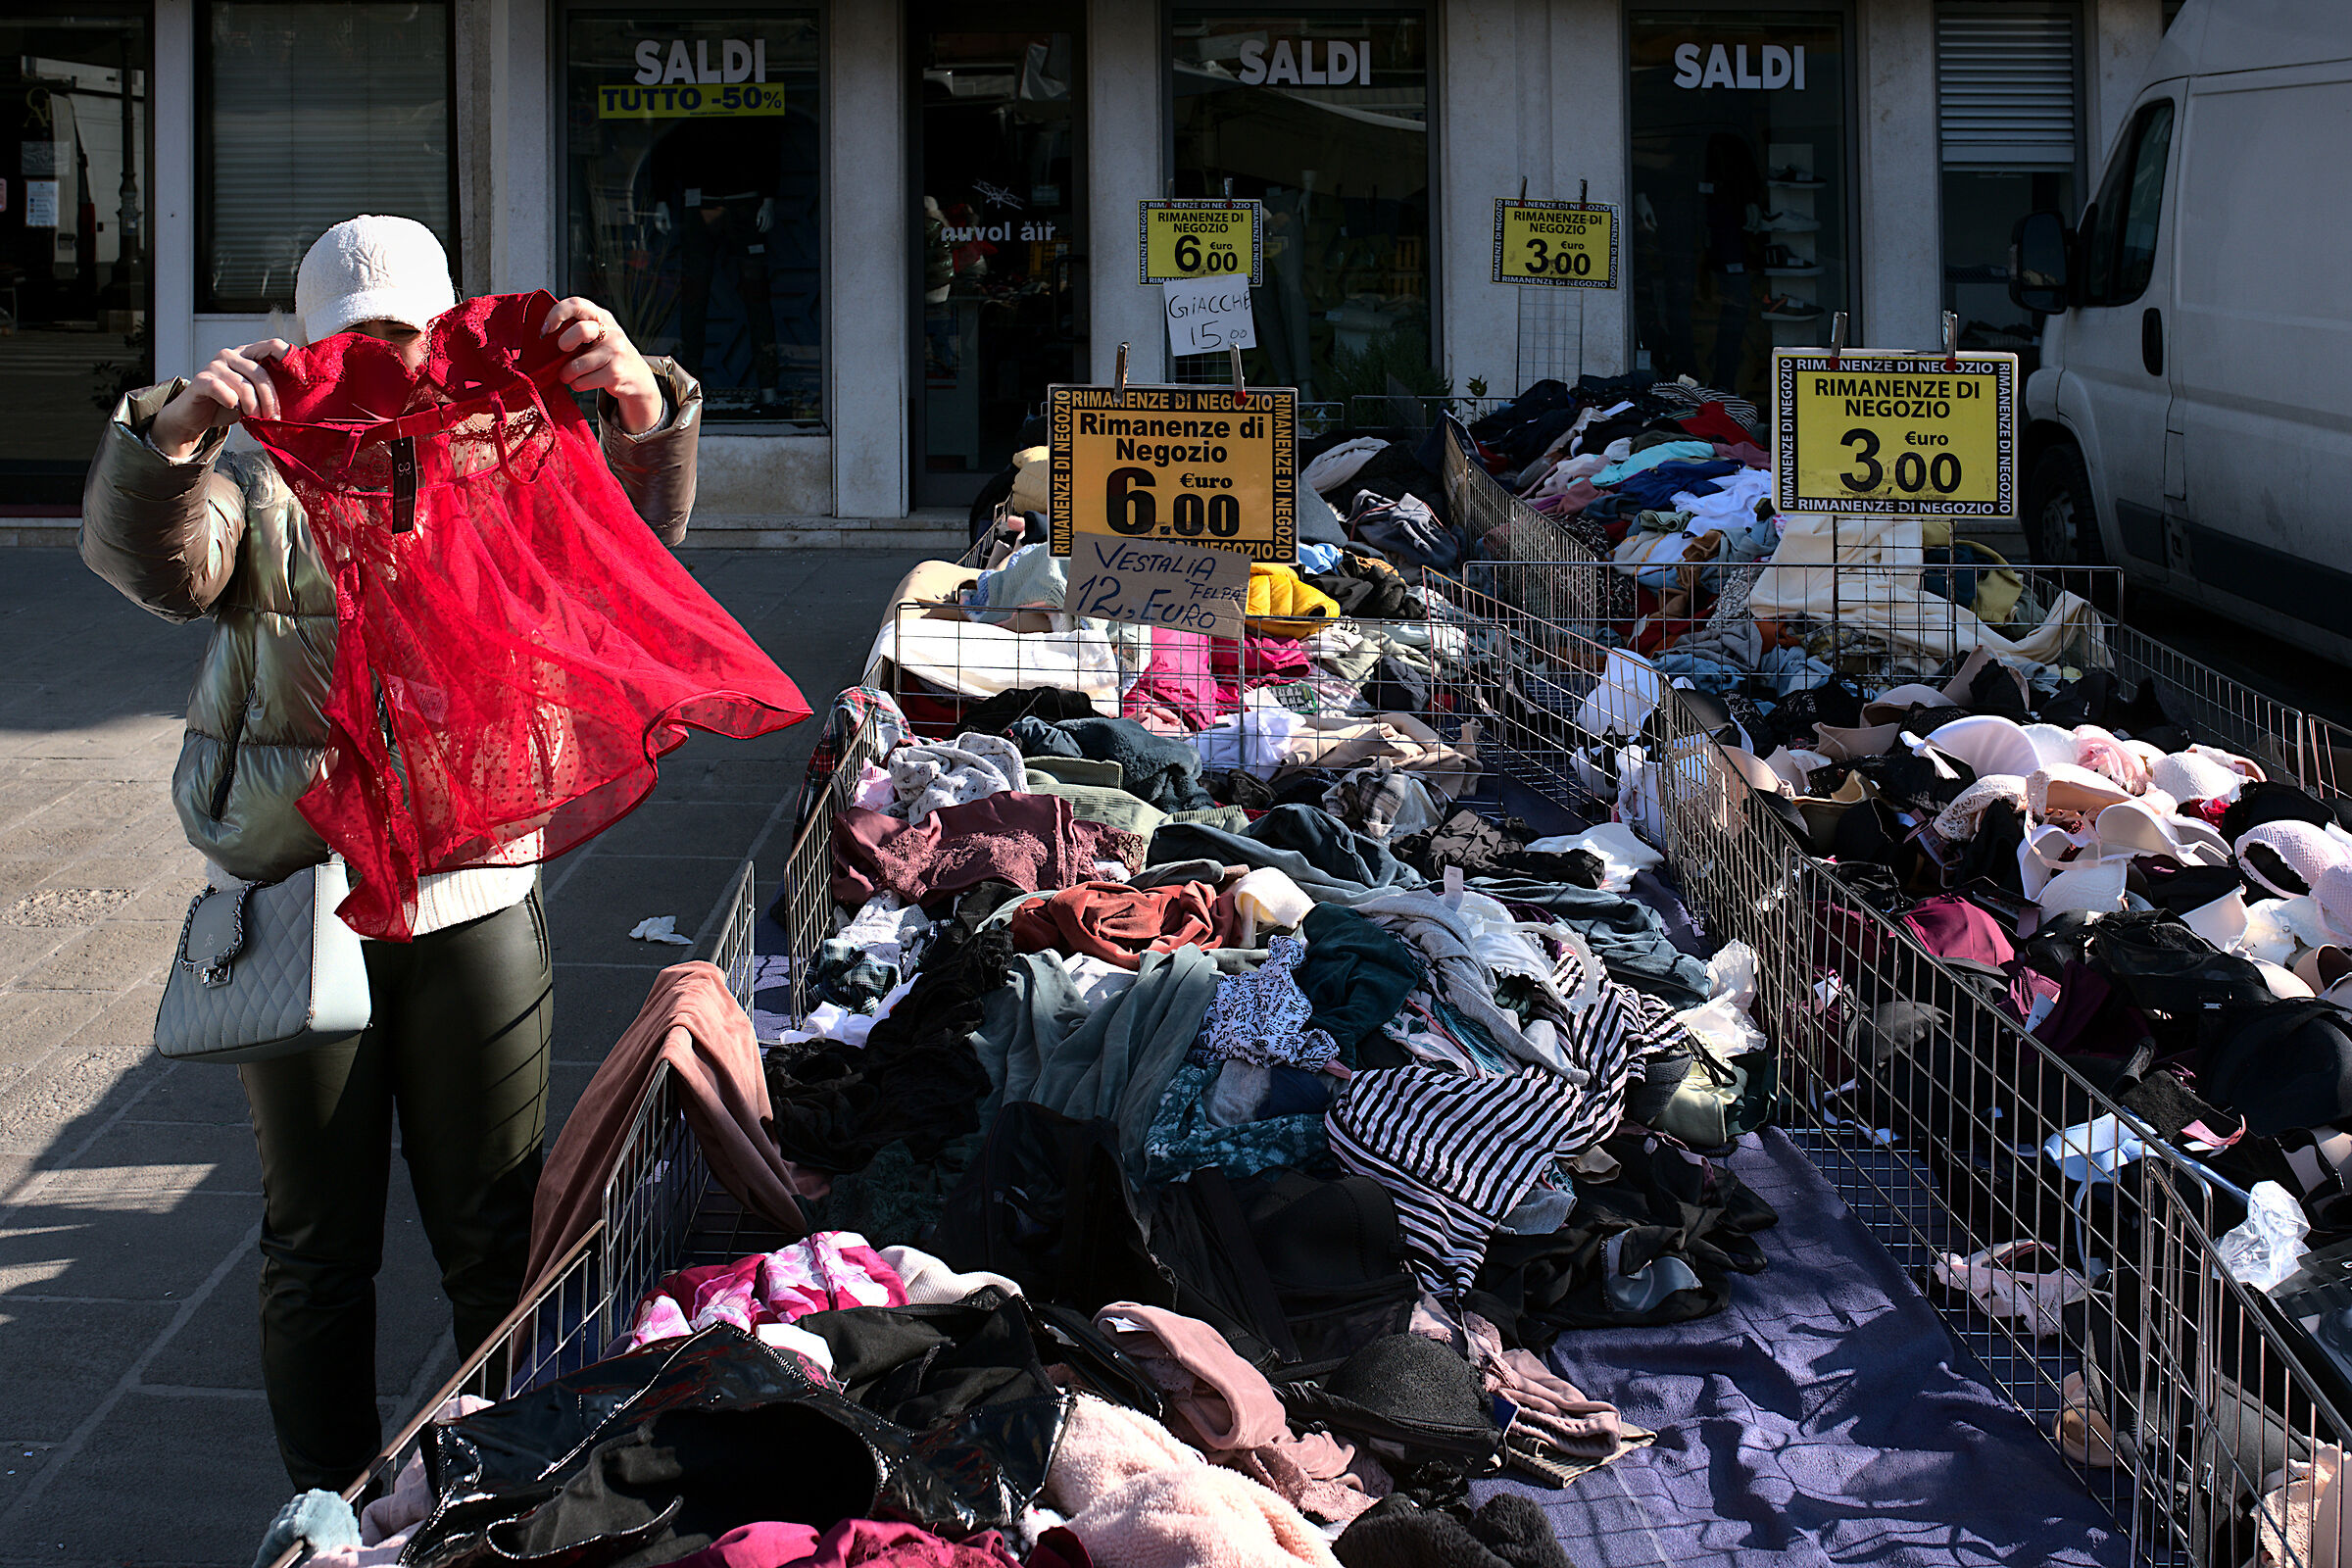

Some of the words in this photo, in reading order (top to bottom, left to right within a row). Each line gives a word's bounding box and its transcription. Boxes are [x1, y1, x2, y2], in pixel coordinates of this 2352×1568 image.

[634, 38, 765, 85] SALDI
[1238, 39, 1371, 85] SALDI
[1673, 42, 1805, 90] SALDI
[602, 87, 702, 112] TUTTO
[711, 86, 782, 110] -50%
[1157, 213, 1229, 222] RIMANENZE
[1231, 213, 1244, 222] DI
[1570, 203, 1609, 212] NEOZIO
[1174, 223, 1229, 233] NEGOZIO
[1514, 211, 1587, 224] RIMANENZE
[1589, 216, 1602, 225] DI
[941, 221, 1010, 241] nuvol
[1020, 225, 1056, 241] air
[1529, 222, 1586, 235] NEGOZIO
[1502, 275, 1553, 285] RIMANENZE
[1567, 279, 1607, 288] NEGOZIO
[1796, 359, 1893, 371] RIMNENZE
[1897, 361, 1914, 372] DI
[1781, 359, 1793, 416] NEGOZIO
[1815, 378, 1951, 398] RIMANENZE
[1957, 381, 1981, 399] DI
[1175, 393, 1192, 410] DI
[1845, 399, 1951, 418] NEGOZIO
[1999, 363, 2011, 437] RIMANENZE
[1054, 390, 1071, 452] NEGOZIO
[1080, 413, 1230, 438] Rimanenze
[1240, 416, 1264, 439] di
[1782, 418, 1793, 432] DI
[1275, 394, 1293, 476] RIMANENZE
[1116, 438, 1227, 467] Negozio
[1999, 440, 2011, 454] DI
[1054, 456, 1071, 469] DI
[1782, 434, 1793, 509] RIMANENZE
[1276, 479, 1293, 493] DI
[1999, 457, 2011, 514] NEGOZIO
[1054, 473, 1070, 555] RIMANENZE
[1798, 499, 1894, 514] RIMANENZE
[1898, 501, 1916, 514] DI
[1920, 502, 1994, 514] NEGOZIO
[1275, 497, 1293, 560] NEGOZIO
